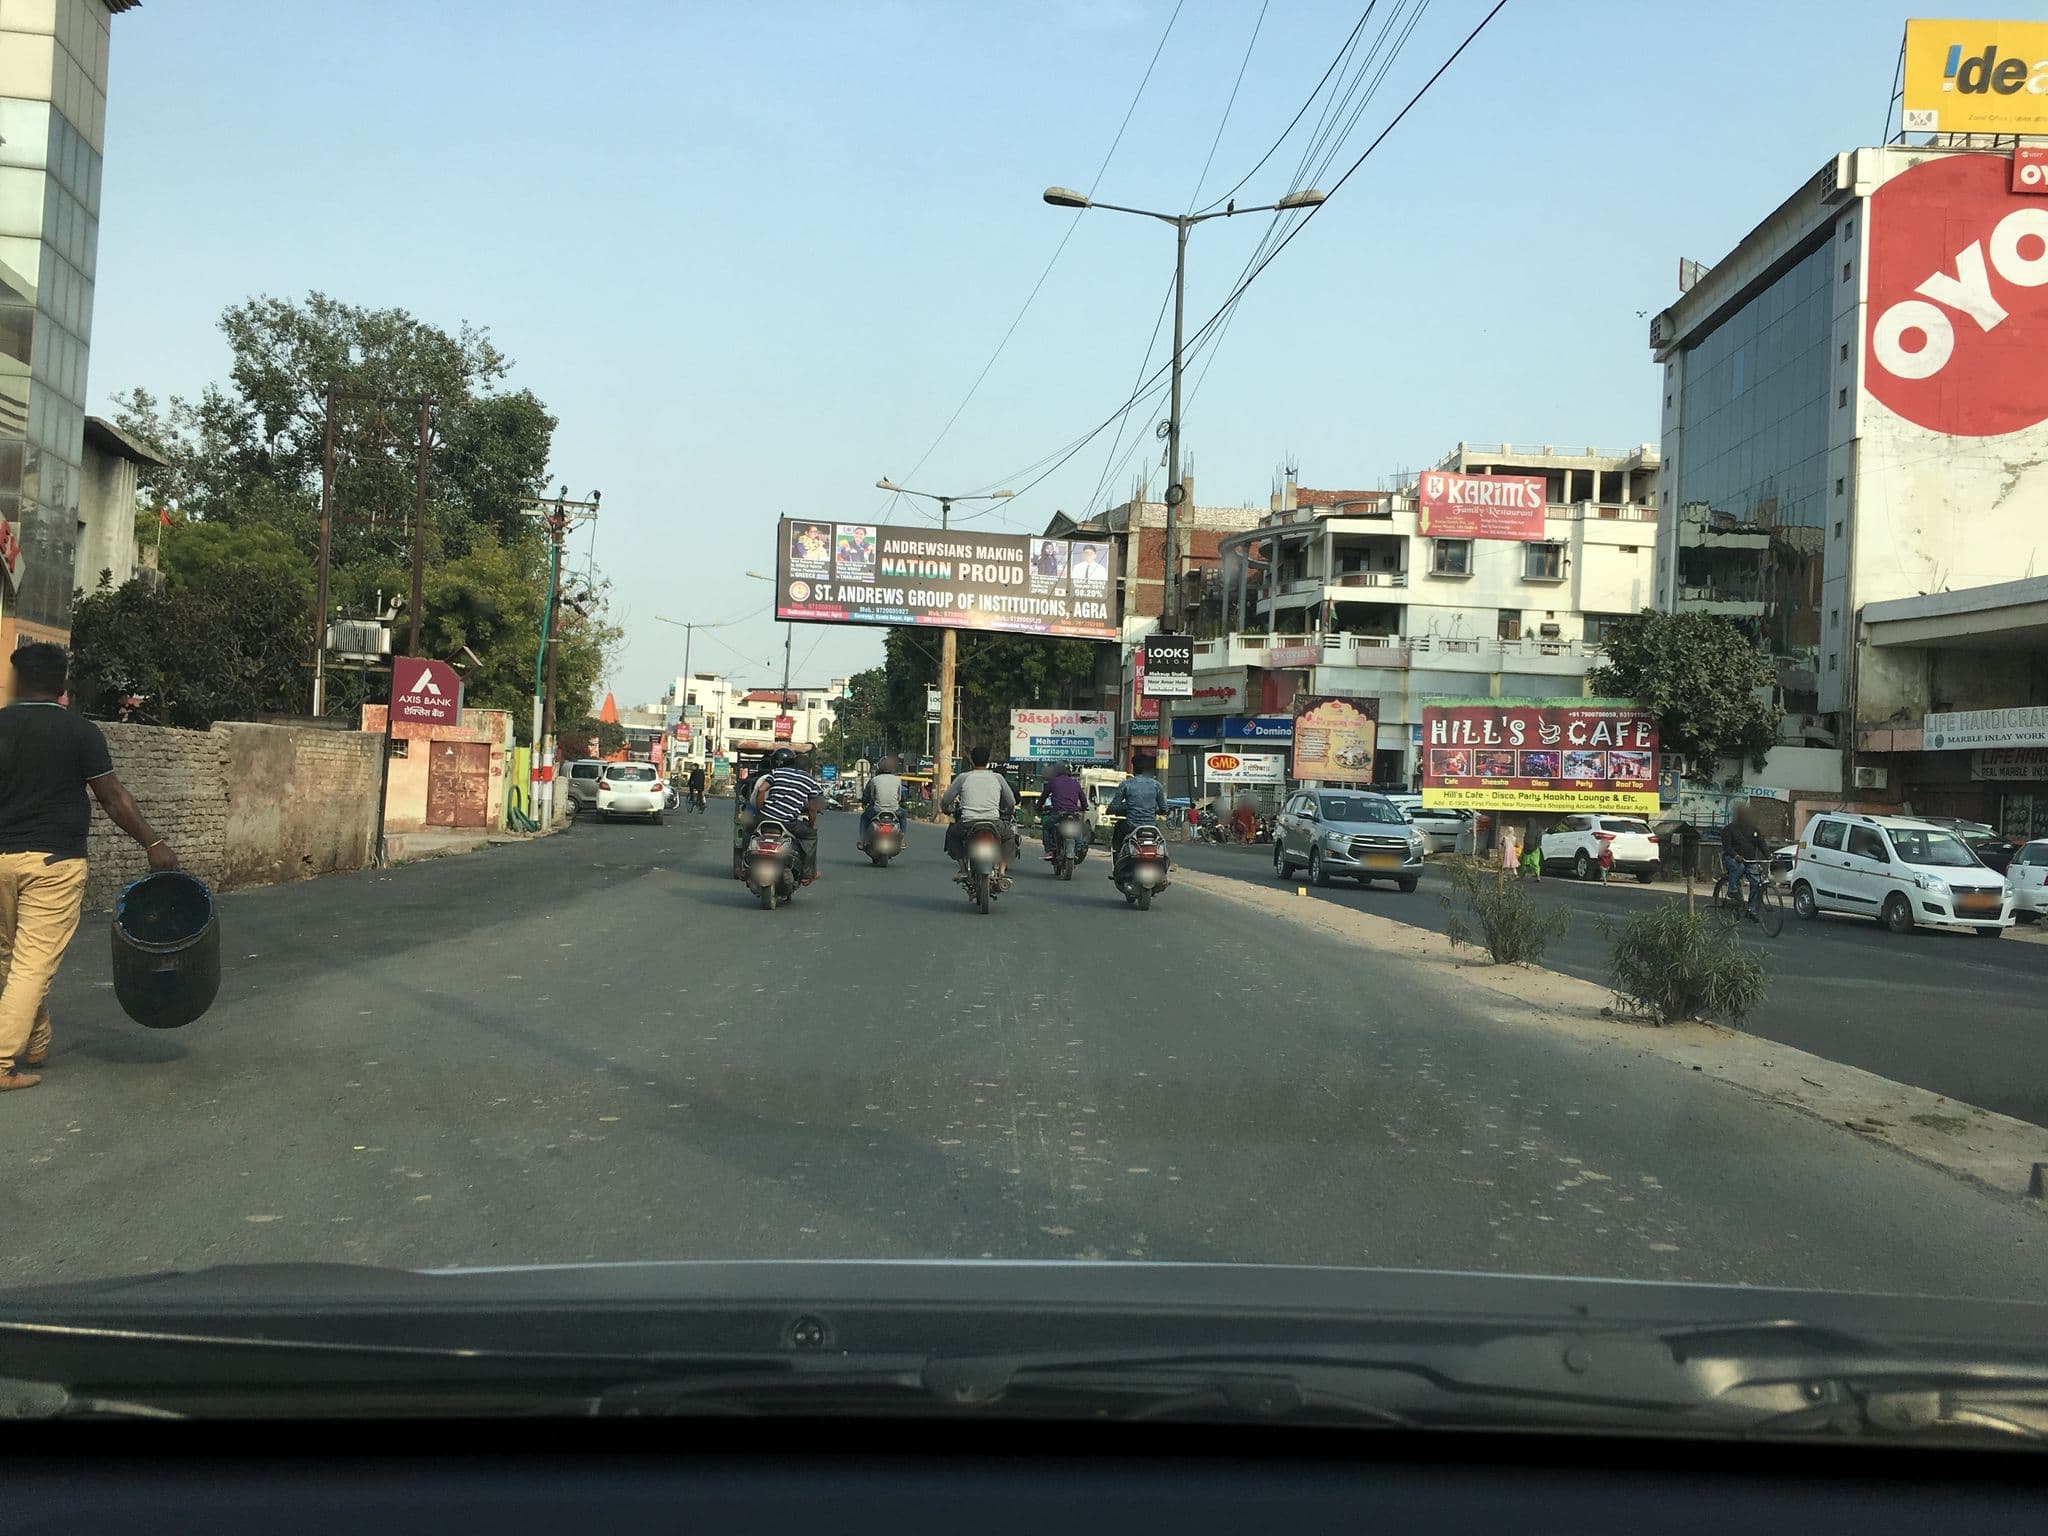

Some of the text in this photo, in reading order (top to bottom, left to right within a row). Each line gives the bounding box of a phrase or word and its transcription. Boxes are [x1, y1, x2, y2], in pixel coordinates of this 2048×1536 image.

[1452, 504, 1485, 517] Family
[1487, 507, 1534, 517] Restaurant
[883, 539, 1024, 562] ANDREWSIANS MAKING
[881, 557, 952, 580] NATION
[958, 562, 1024, 585] PROUD
[814, 583, 833, 601] ST.
[837, 585, 904, 606] ANDREWS
[908, 589, 954, 609] GROUP
[957, 592, 975, 610] OF
[979, 594, 1070, 619] INSTITUTIONS,
[1073, 601, 1108, 619] AGRA
[1148, 647, 1190, 659] LOOKS
[398, 695, 452, 707] AXIS BANK
[1925, 713, 1957, 733] LIFE
[1050, 728, 1066, 736] Only
[1255, 725, 1294, 737] Domino'
[1430, 715, 1653, 748] HILL'S CAFE
[1036, 736, 1089, 746] Meher Cinema
[1947, 732, 2046, 744] MARBLE INLAY WORK
[1036, 747, 1088, 756] Heritage Villa
[1210, 755, 1238, 769] GMB
[1575, 780, 1593, 789] Party
[1631, 781, 1644, 789] Top
[1443, 790, 1463, 799] Hill's
[1465, 791, 1484, 799] Cafe
[1543, 793, 1576, 801] Hookha
[1578, 793, 1608, 803] Lounge
[1612, 794, 1619, 802] &
